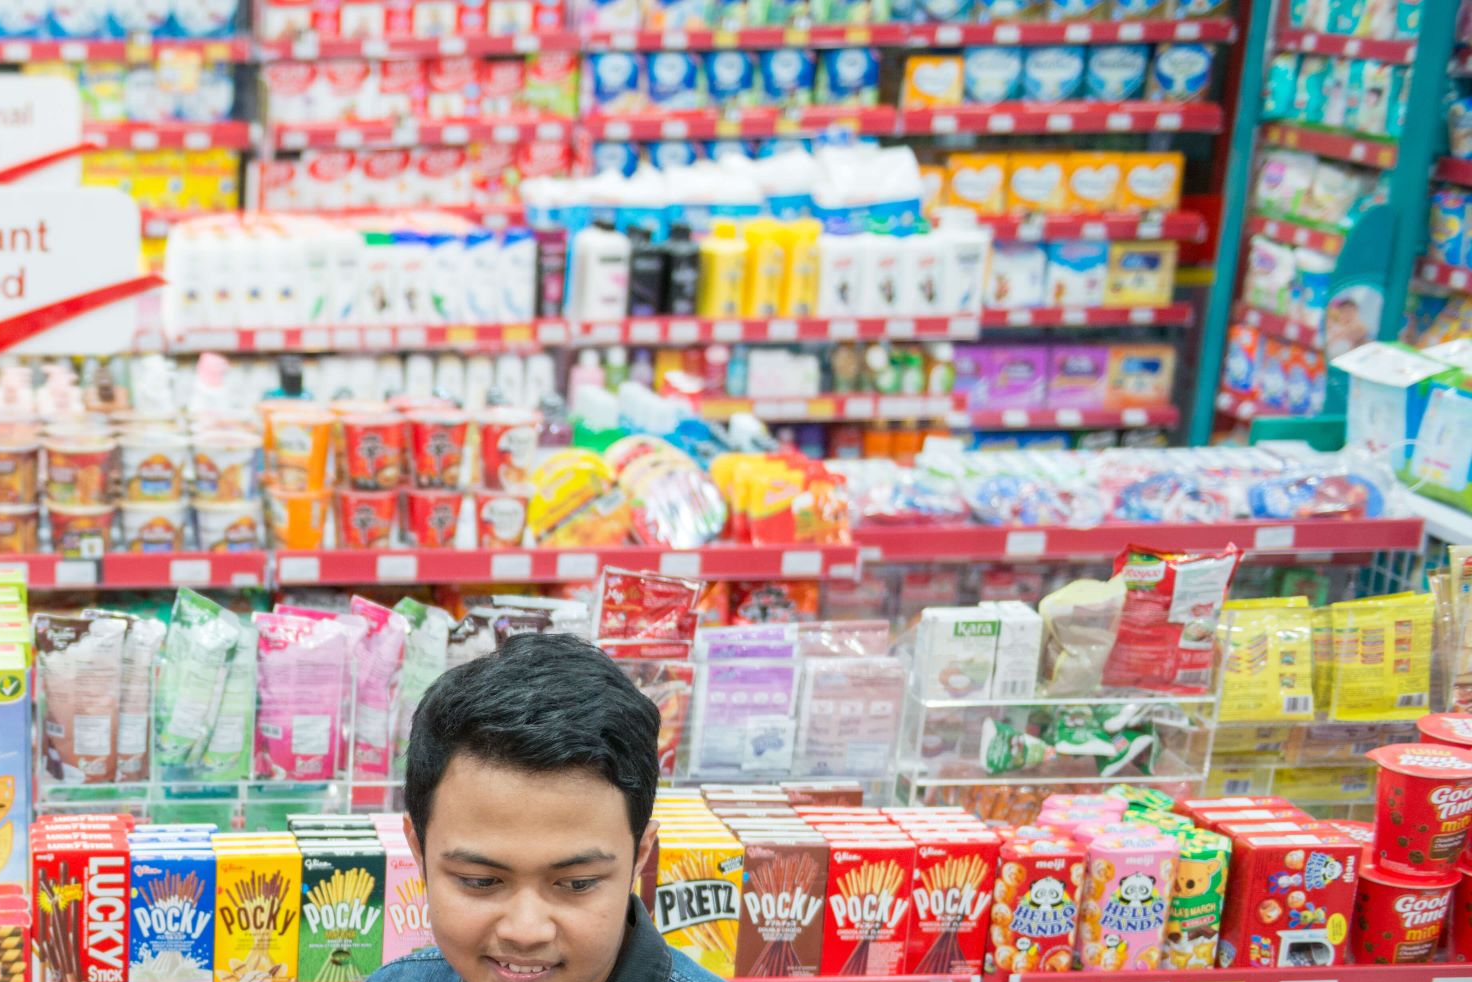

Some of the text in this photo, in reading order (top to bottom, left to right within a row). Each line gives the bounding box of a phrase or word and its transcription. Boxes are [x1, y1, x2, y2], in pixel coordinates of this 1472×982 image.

[957, 621, 996, 636] kara
[1035, 860, 1066, 871] meiji
[1125, 857, 1155, 868] meiji
[1342, 855, 1356, 884] meiji
[87, 855, 126, 966] LUCKY
[657, 880, 736, 928] PRETZ
[1104, 901, 1165, 919] HELLO
[1394, 891, 1451, 913] Good
[1014, 904, 1076, 922] HELLO
[1401, 906, 1448, 929] Time
[1010, 918, 1076, 938] PANDA
[1099, 915, 1165, 935] PANDA
[1405, 922, 1441, 942] mini
